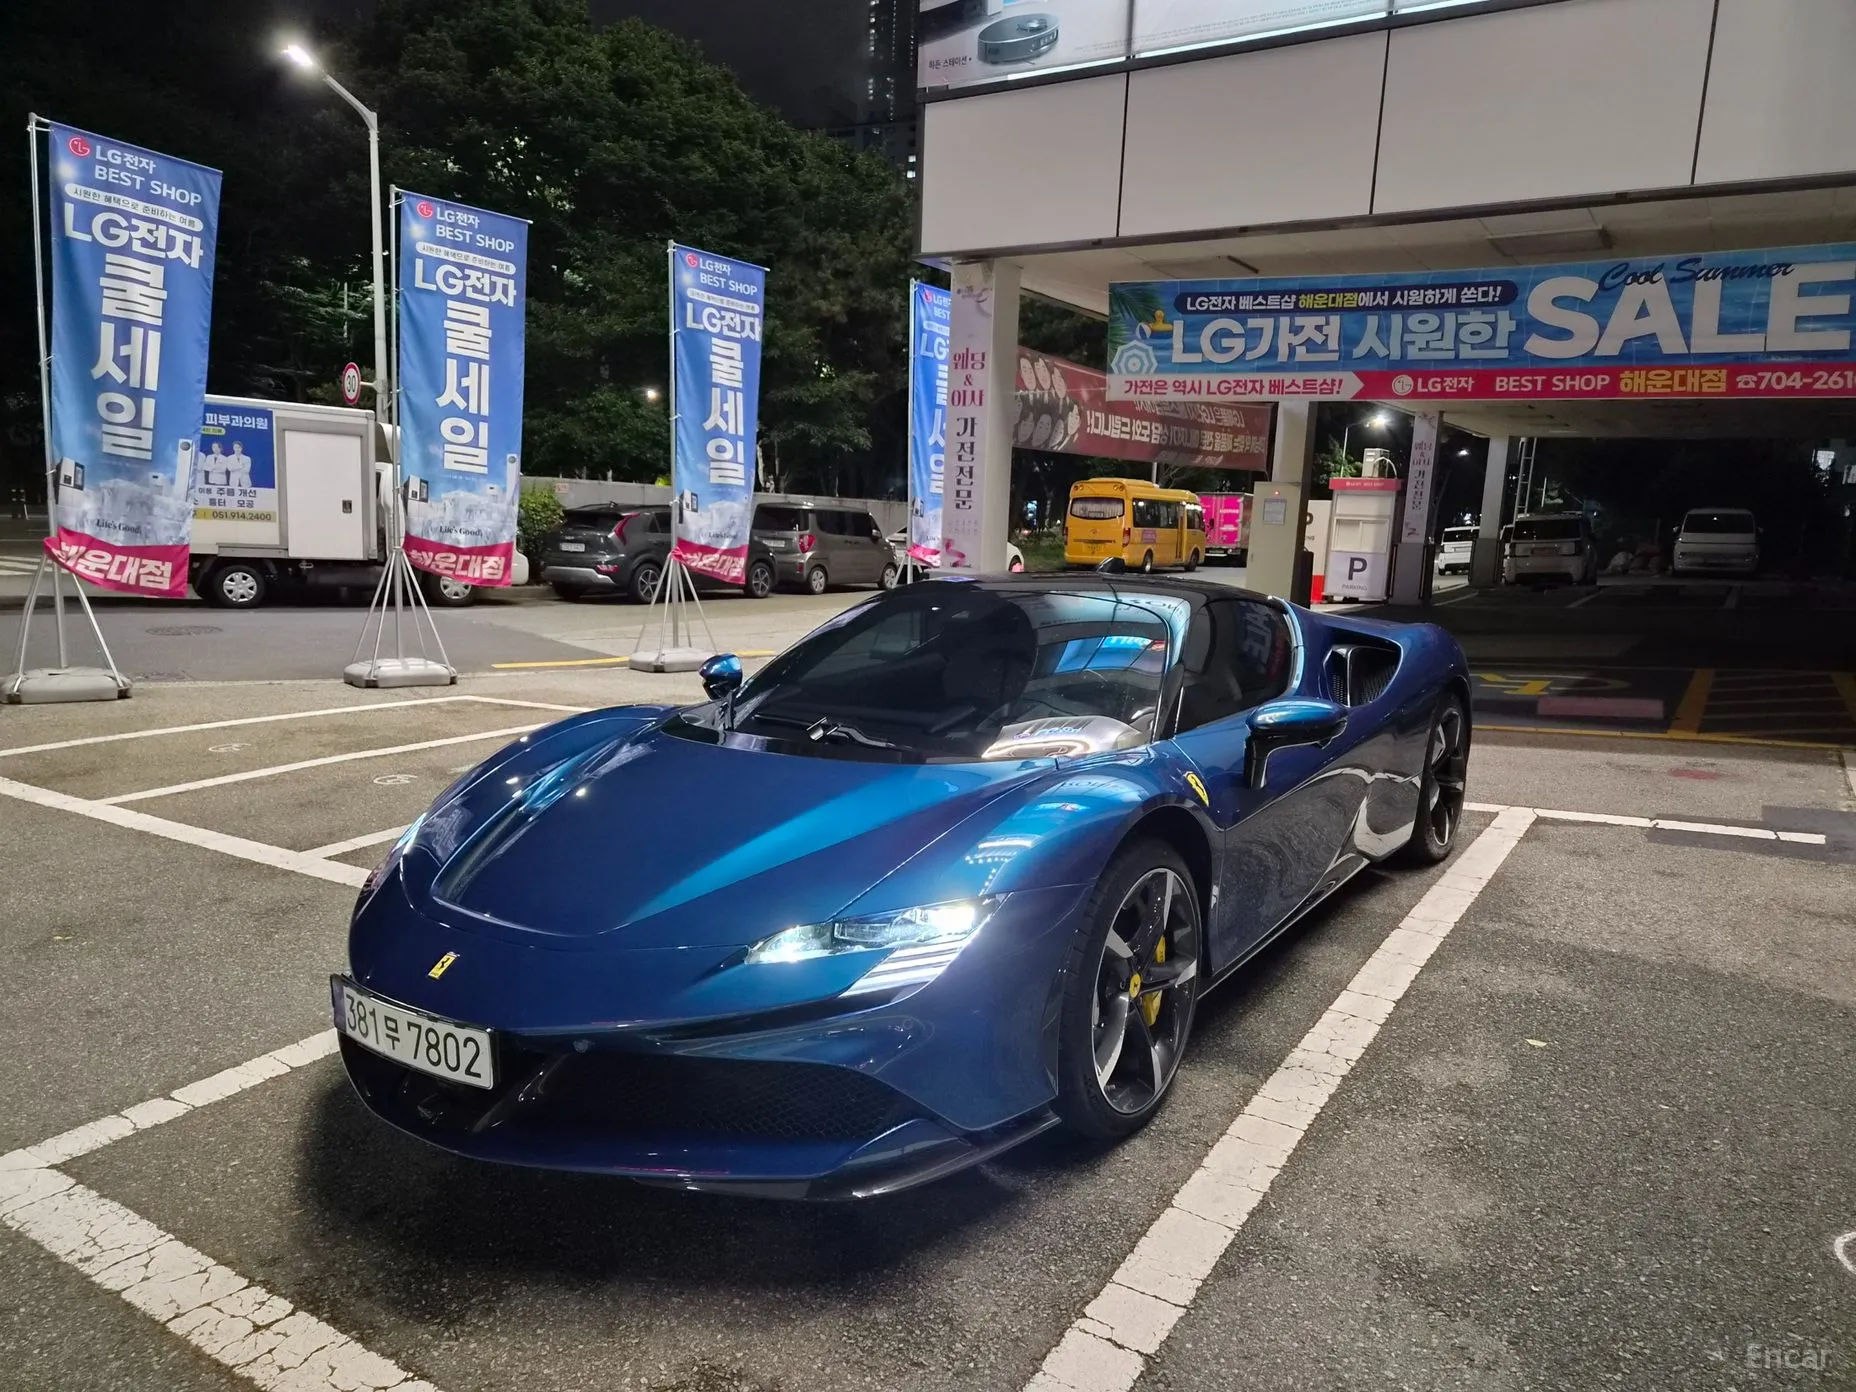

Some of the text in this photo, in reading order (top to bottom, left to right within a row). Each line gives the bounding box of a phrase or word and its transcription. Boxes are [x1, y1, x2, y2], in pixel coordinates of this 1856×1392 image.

[95, 145, 157, 174] LG전자
[73, 187, 101, 201] 시원한
[95, 165, 203, 207] BEST SHOP
[436, 206, 480, 229] LG전자
[64, 201, 204, 269] LG전자
[436, 223, 515, 254] BEST SHOP
[699, 257, 732, 277] LG전자
[1598, 257, 1797, 292] Cool Summer
[414, 258, 517, 308] LG전자
[700, 273, 758, 296] BEST SHOP
[1186, 295, 1237, 311] LG전자
[1238, 294, 1297, 310] 베스트샵
[1298, 291, 1390, 309] 해운대점에서
[1391, 287, 1457, 307] 시원하게
[1523, 260, 1856, 359] SALE
[686, 302, 763, 342] LG전자
[1171, 310, 1517, 364] LG가전 시원한
[953, 347, 986, 371] 웨딩
[963, 374, 973, 387] &
[1124, 378, 1344, 396] 가전은 역시 LG전자 베스트샵!
[1417, 369, 1856, 393] LG전자 BEST SHOP 해운대점 704-261
[951, 389, 985, 407] 이사
[205, 412, 269, 430] 피부과의원
[236, 499, 255, 508] 모공
[238, 488, 257, 498] 개선
[212, 510, 272, 522] 051.914.2400
[1348, 557, 1368, 581] P
[345, 993, 482, 1079] 381무 7802
